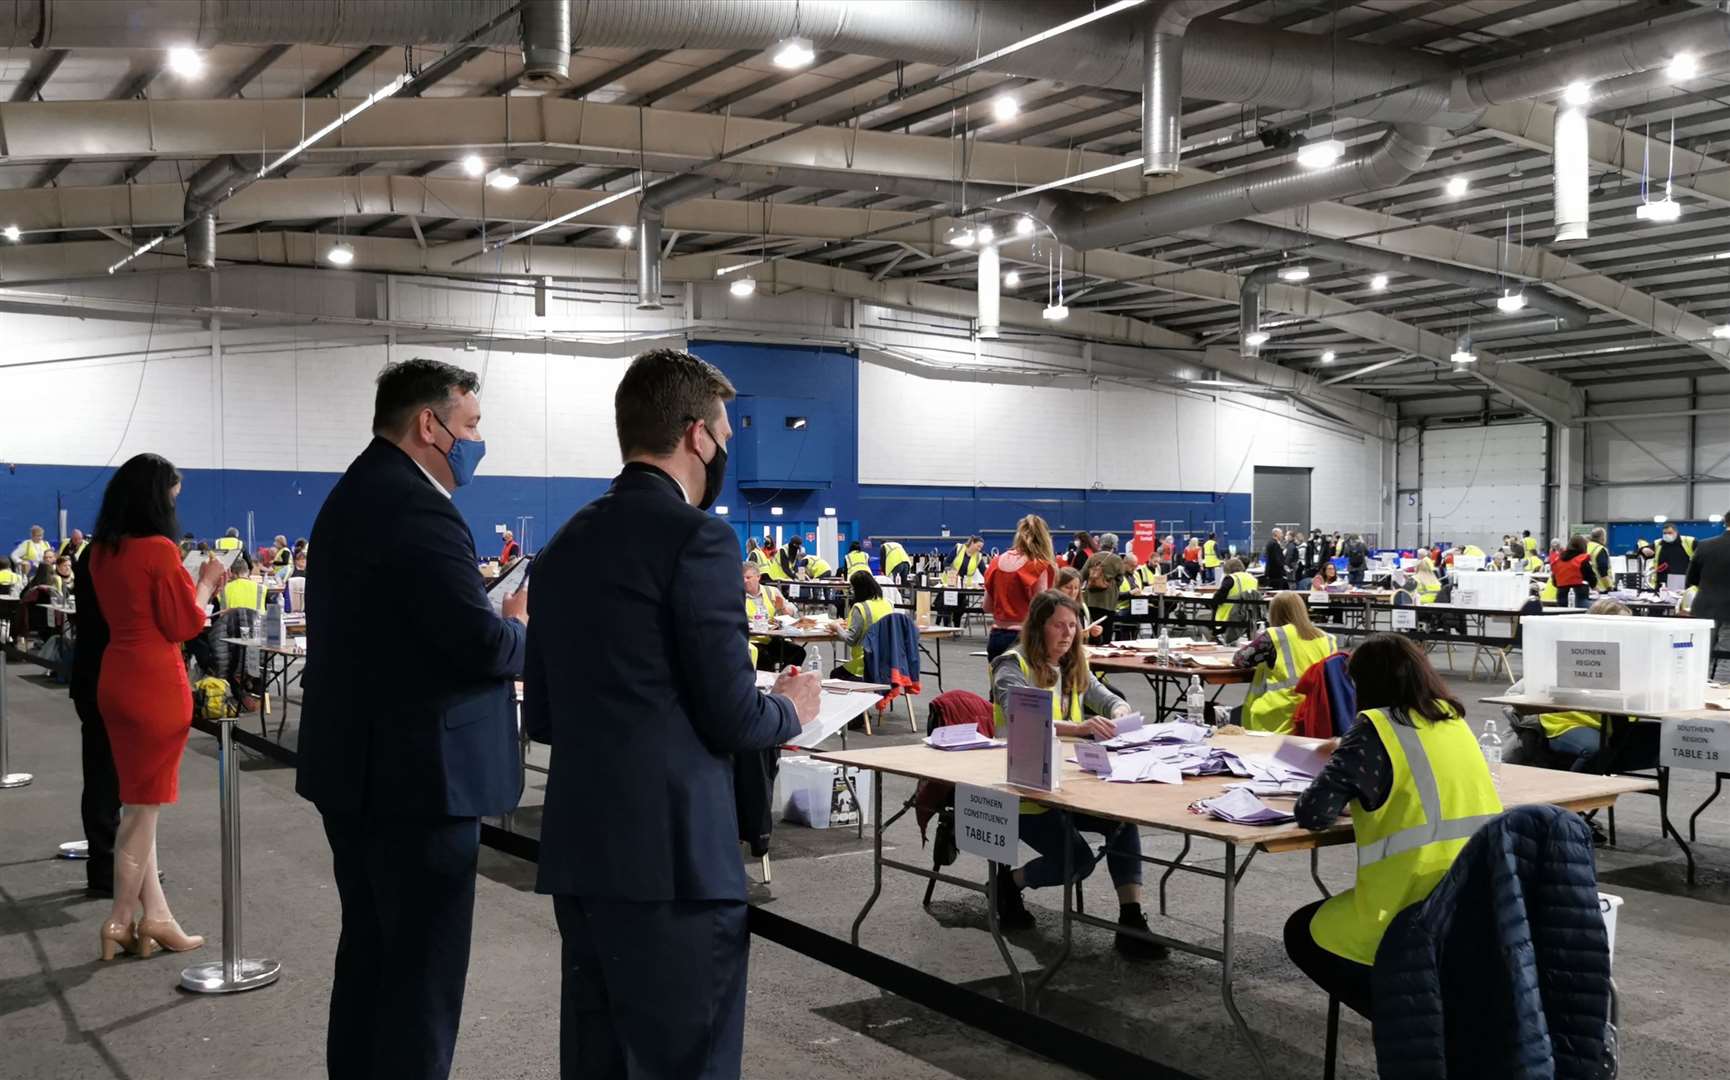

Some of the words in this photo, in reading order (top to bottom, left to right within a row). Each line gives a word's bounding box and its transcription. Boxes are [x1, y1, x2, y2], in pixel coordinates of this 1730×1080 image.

[1571, 648, 1606, 656] SOUTHERN
[1575, 659, 1601, 667] REGION
[1573, 670, 1593, 678] TABLE
[1595, 671, 1603, 679] 18
[1677, 724, 1715, 733] SOUTHERN
[1682, 735, 1708, 744] REGION
[1672, 747, 1702, 760] TABLE
[1706, 751, 1719, 761] 18
[970, 794, 1003, 808] SOUTHERN
[963, 808, 1008, 824] CONSTITUENCY
[965, 826, 992, 843] TABLE
[994, 834, 1006, 847] 18
